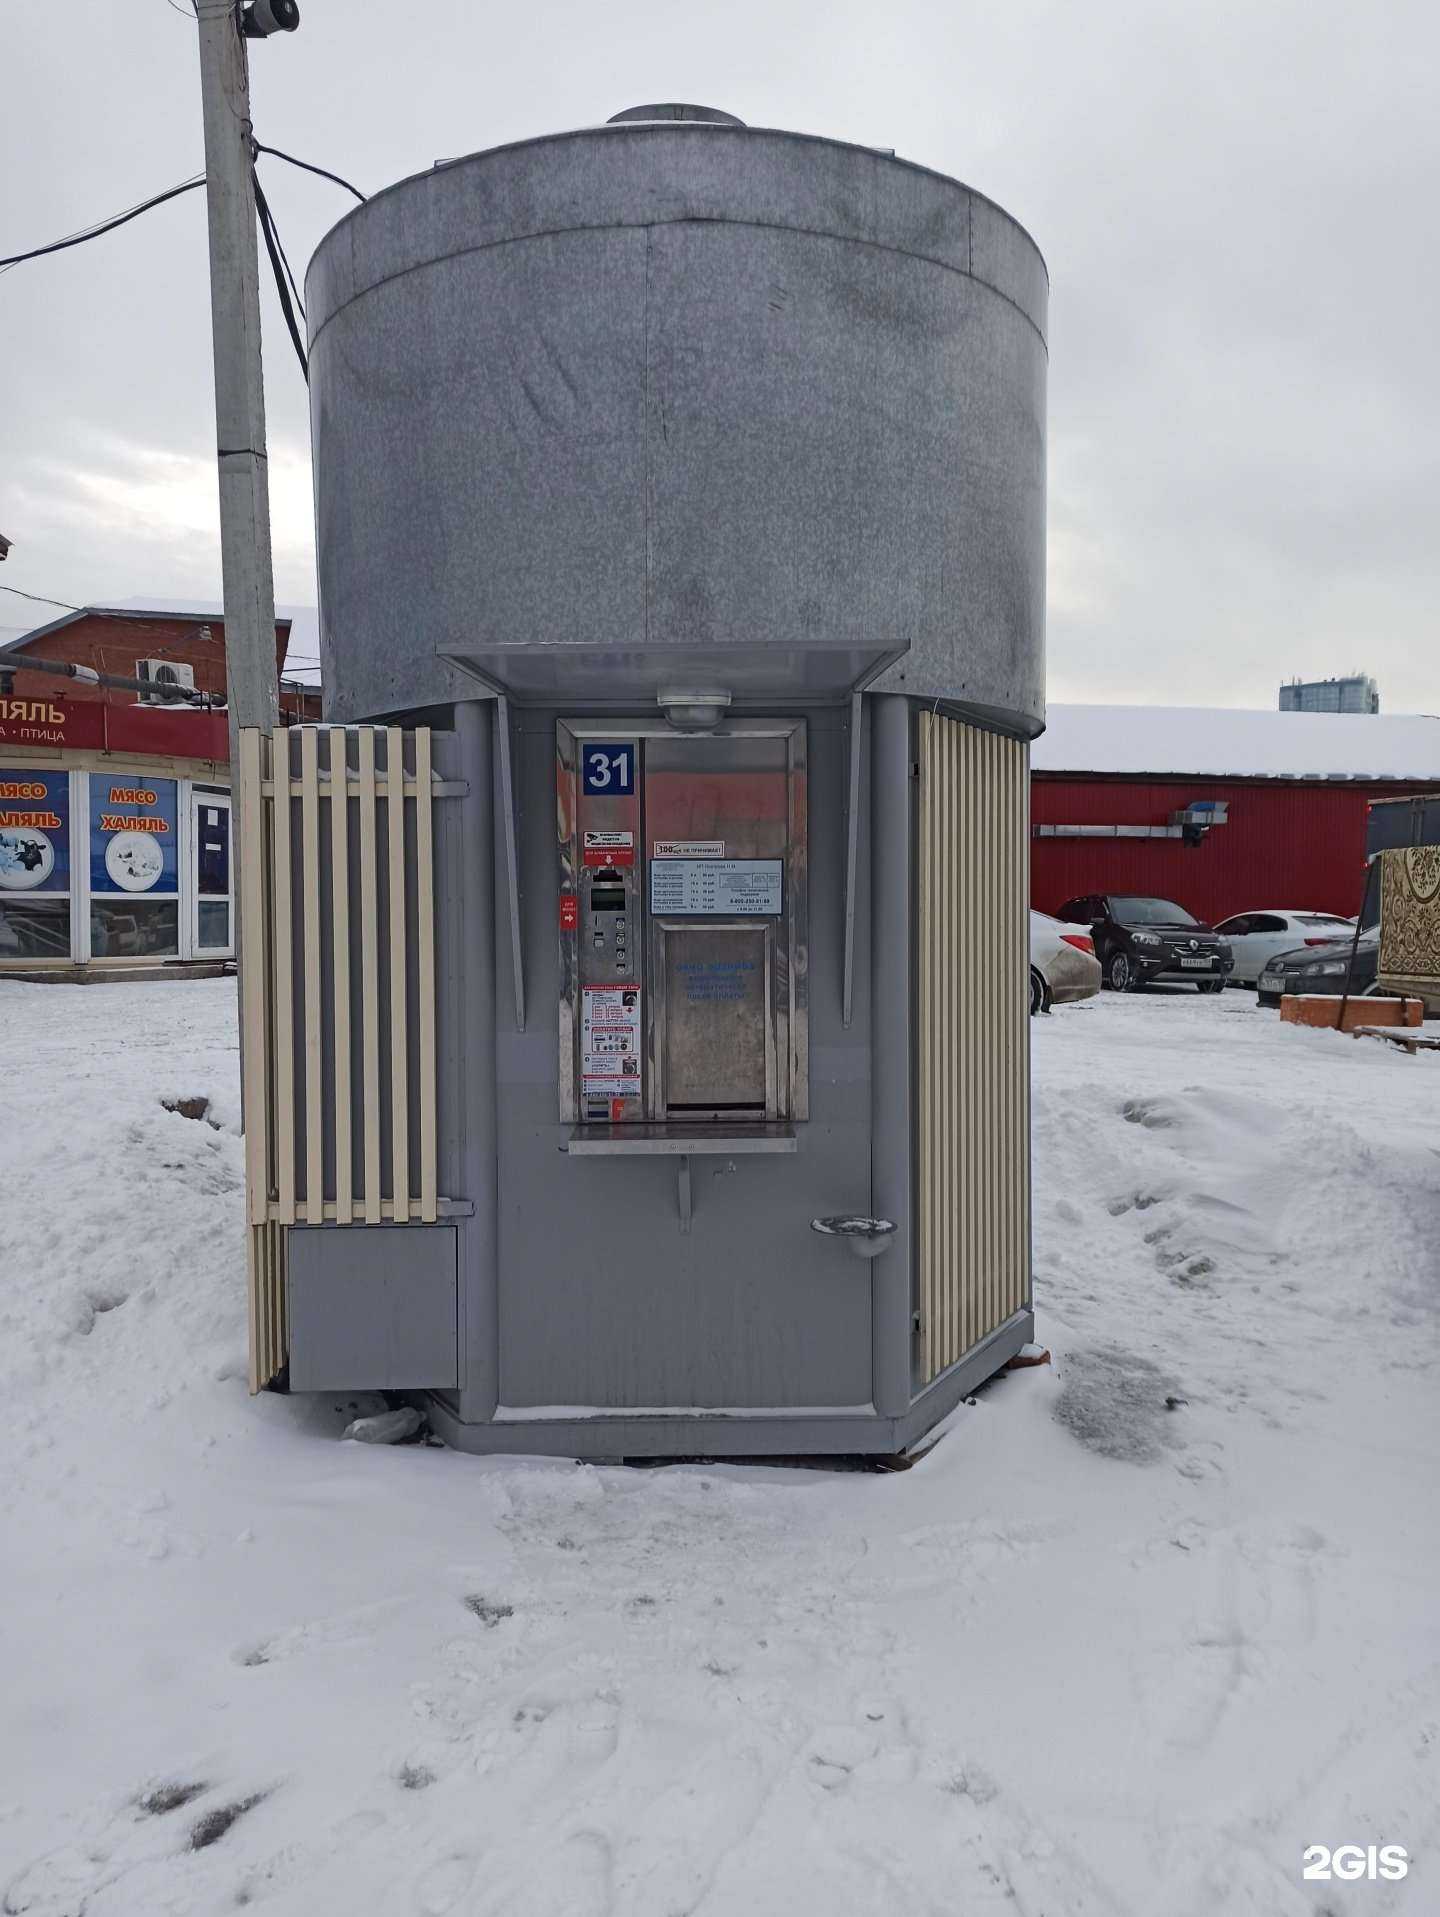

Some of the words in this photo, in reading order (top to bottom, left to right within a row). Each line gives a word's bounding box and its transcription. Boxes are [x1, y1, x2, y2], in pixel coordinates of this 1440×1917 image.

[20, 728, 65, 742] ПТИЦА
[589, 753, 628, 787] 31
[110, 787, 158, 806] МЯСО
[101, 815, 169, 832] ХАЛЯЛЬ
